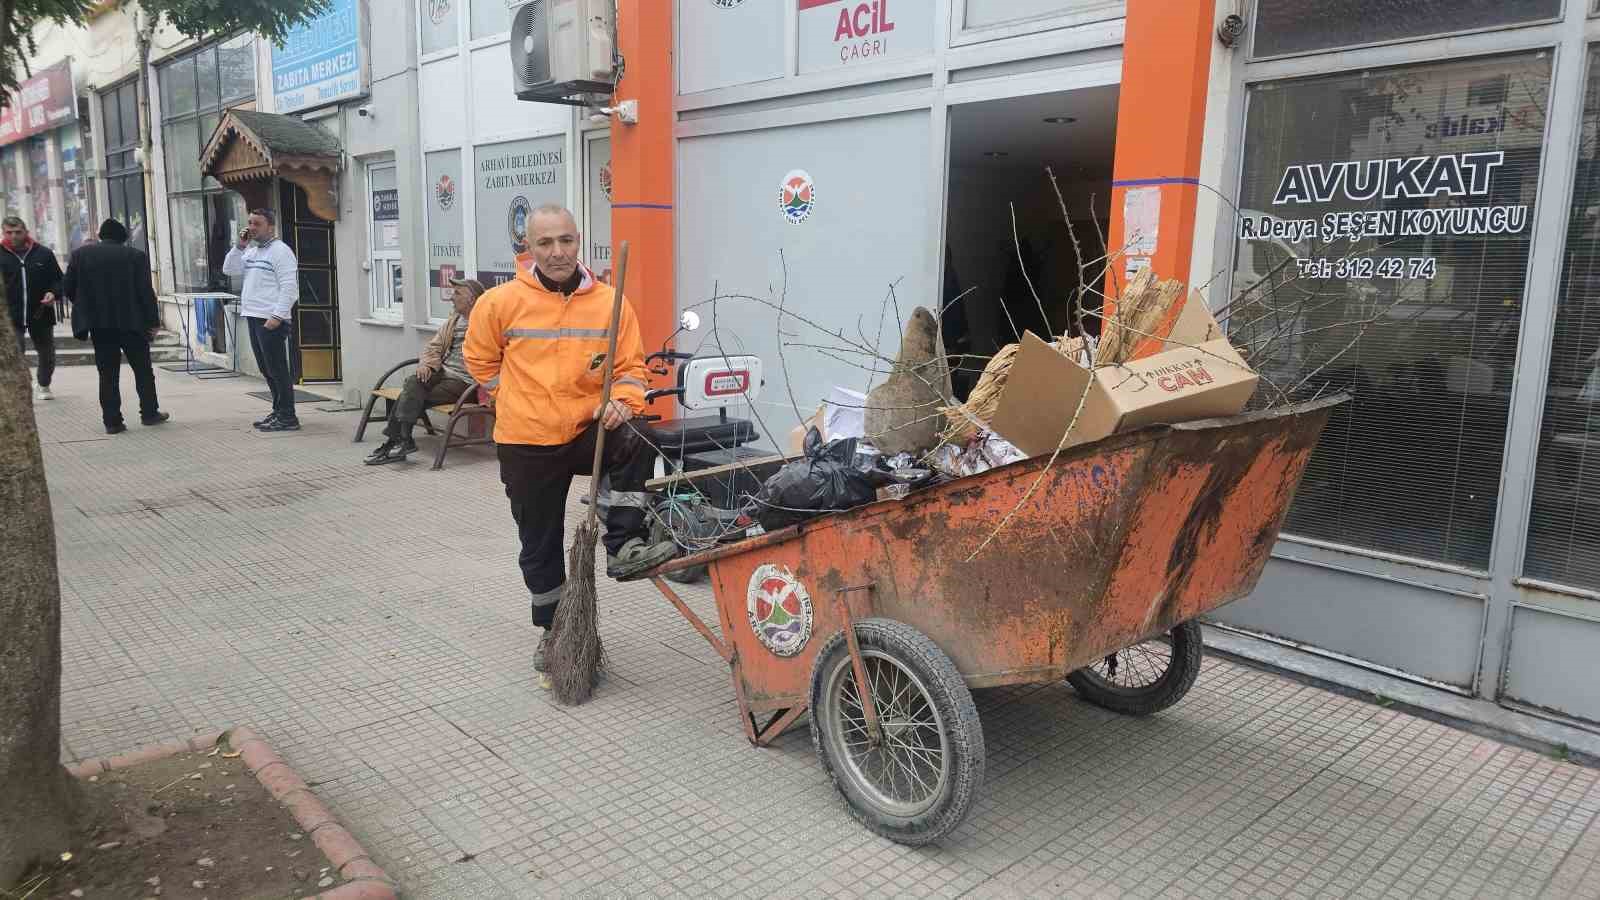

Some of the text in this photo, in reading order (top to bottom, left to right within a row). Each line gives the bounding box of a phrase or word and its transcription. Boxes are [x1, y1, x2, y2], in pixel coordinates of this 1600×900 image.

[834, 0, 895, 42] ACİL
[840, 39, 888, 64] ÇAĞRI
[277, 48, 356, 90] ZABITA MERKEZİ
[480, 148, 562, 172] ARHAVİ BELEDİYESİ
[486, 168, 556, 189] ZABITA MERKEZİ
[1272, 151, 1505, 205] AVUKAT
[1321, 209, 1396, 243] ŞEŞEN
[1400, 205, 1528, 236] KOYUNCU
[1336, 258, 1378, 279] 312
[1378, 258, 1405, 279] 42
[1409, 258, 1436, 279] 74
[1158, 367, 1214, 391] CAM
